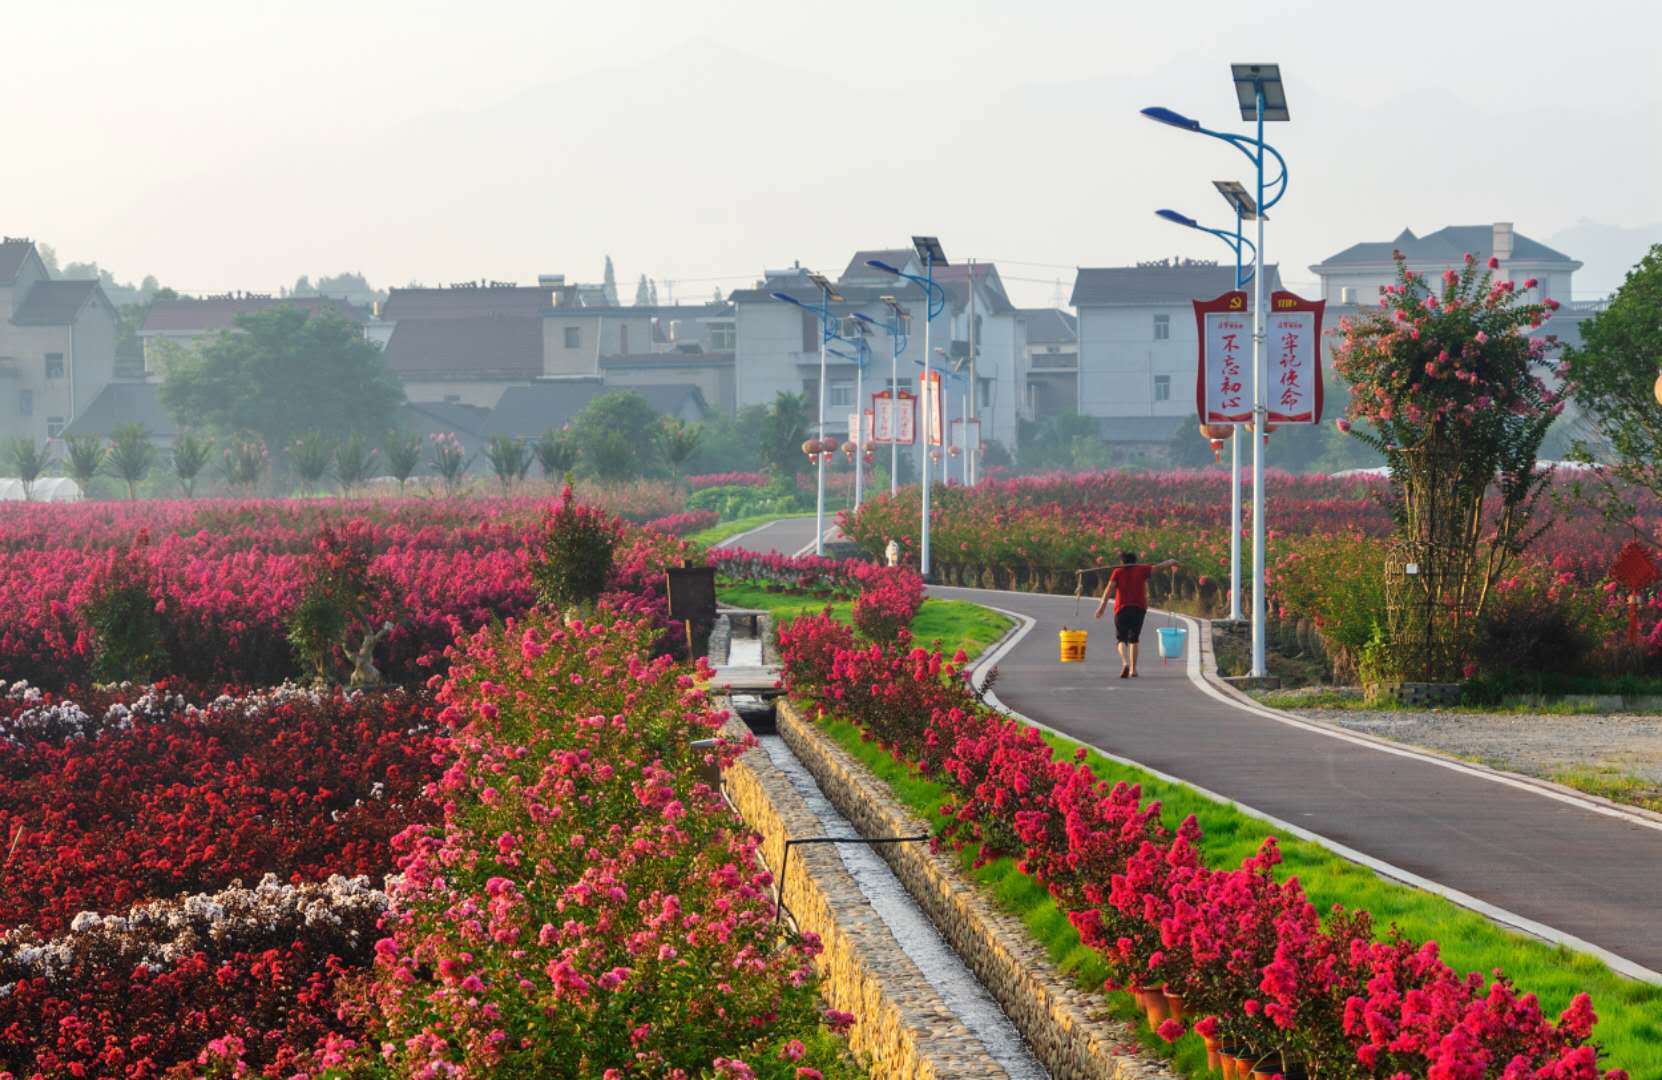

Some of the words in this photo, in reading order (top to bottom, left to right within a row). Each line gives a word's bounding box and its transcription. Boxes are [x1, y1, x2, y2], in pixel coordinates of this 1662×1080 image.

[1220, 333, 1242, 409] 不忘初心
[1280, 332, 1304, 411] 牢记使命
